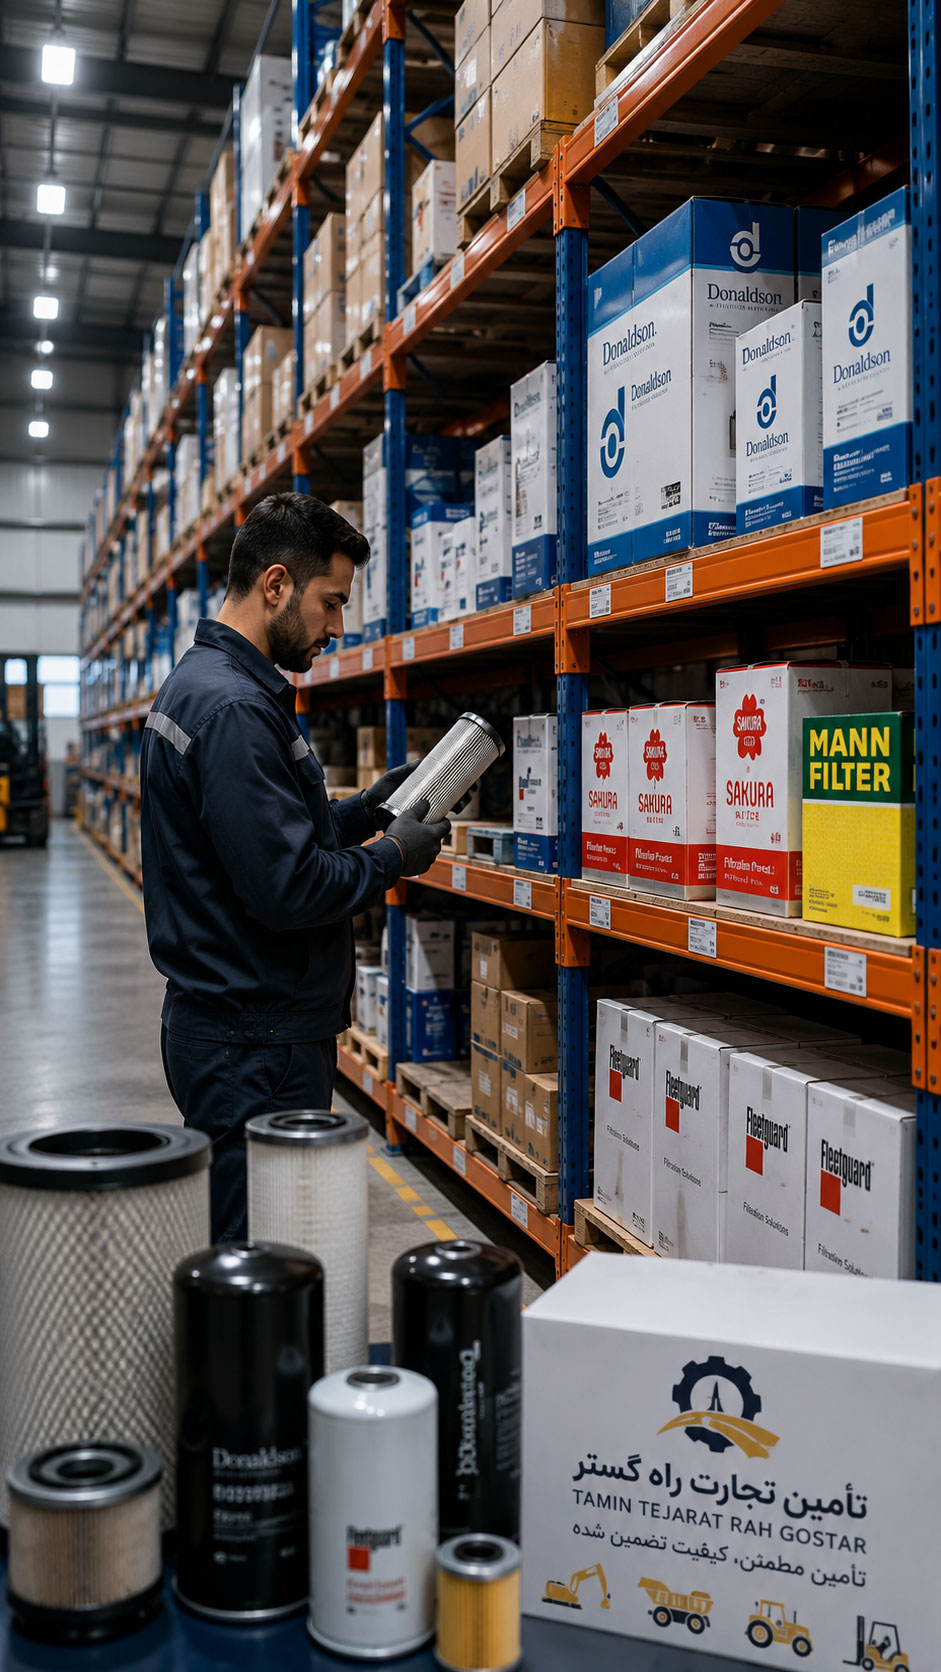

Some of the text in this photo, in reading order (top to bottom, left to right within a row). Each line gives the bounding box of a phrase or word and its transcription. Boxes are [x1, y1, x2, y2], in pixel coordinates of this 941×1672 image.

[707, 283, 782, 305] Donaldson
[833, 350, 891, 384] Donaldson
[631, 370, 671, 401] Donaldson
[746, 432, 789, 457] Donaldson
[809, 727, 890, 757] MANN
[809, 762, 891, 792] FILTER
[638, 793, 672, 815] SAKURA
[726, 780, 774, 808] SAKURA
[746, 1106, 788, 1153] Fleetguard
[821, 1139, 871, 1192] Fleetguard
[572, 1452, 868, 1521] تأمین تجارت راه گستر
[572, 1489, 867, 1555] TAMIN TEJARAT RAH GOSTAR
[572, 1523, 605, 1539] شده
[610, 1532, 667, 1550] تضمین
[672, 1541, 729, 1565] کیفیت
[811, 1564, 867, 1588] تأمین
